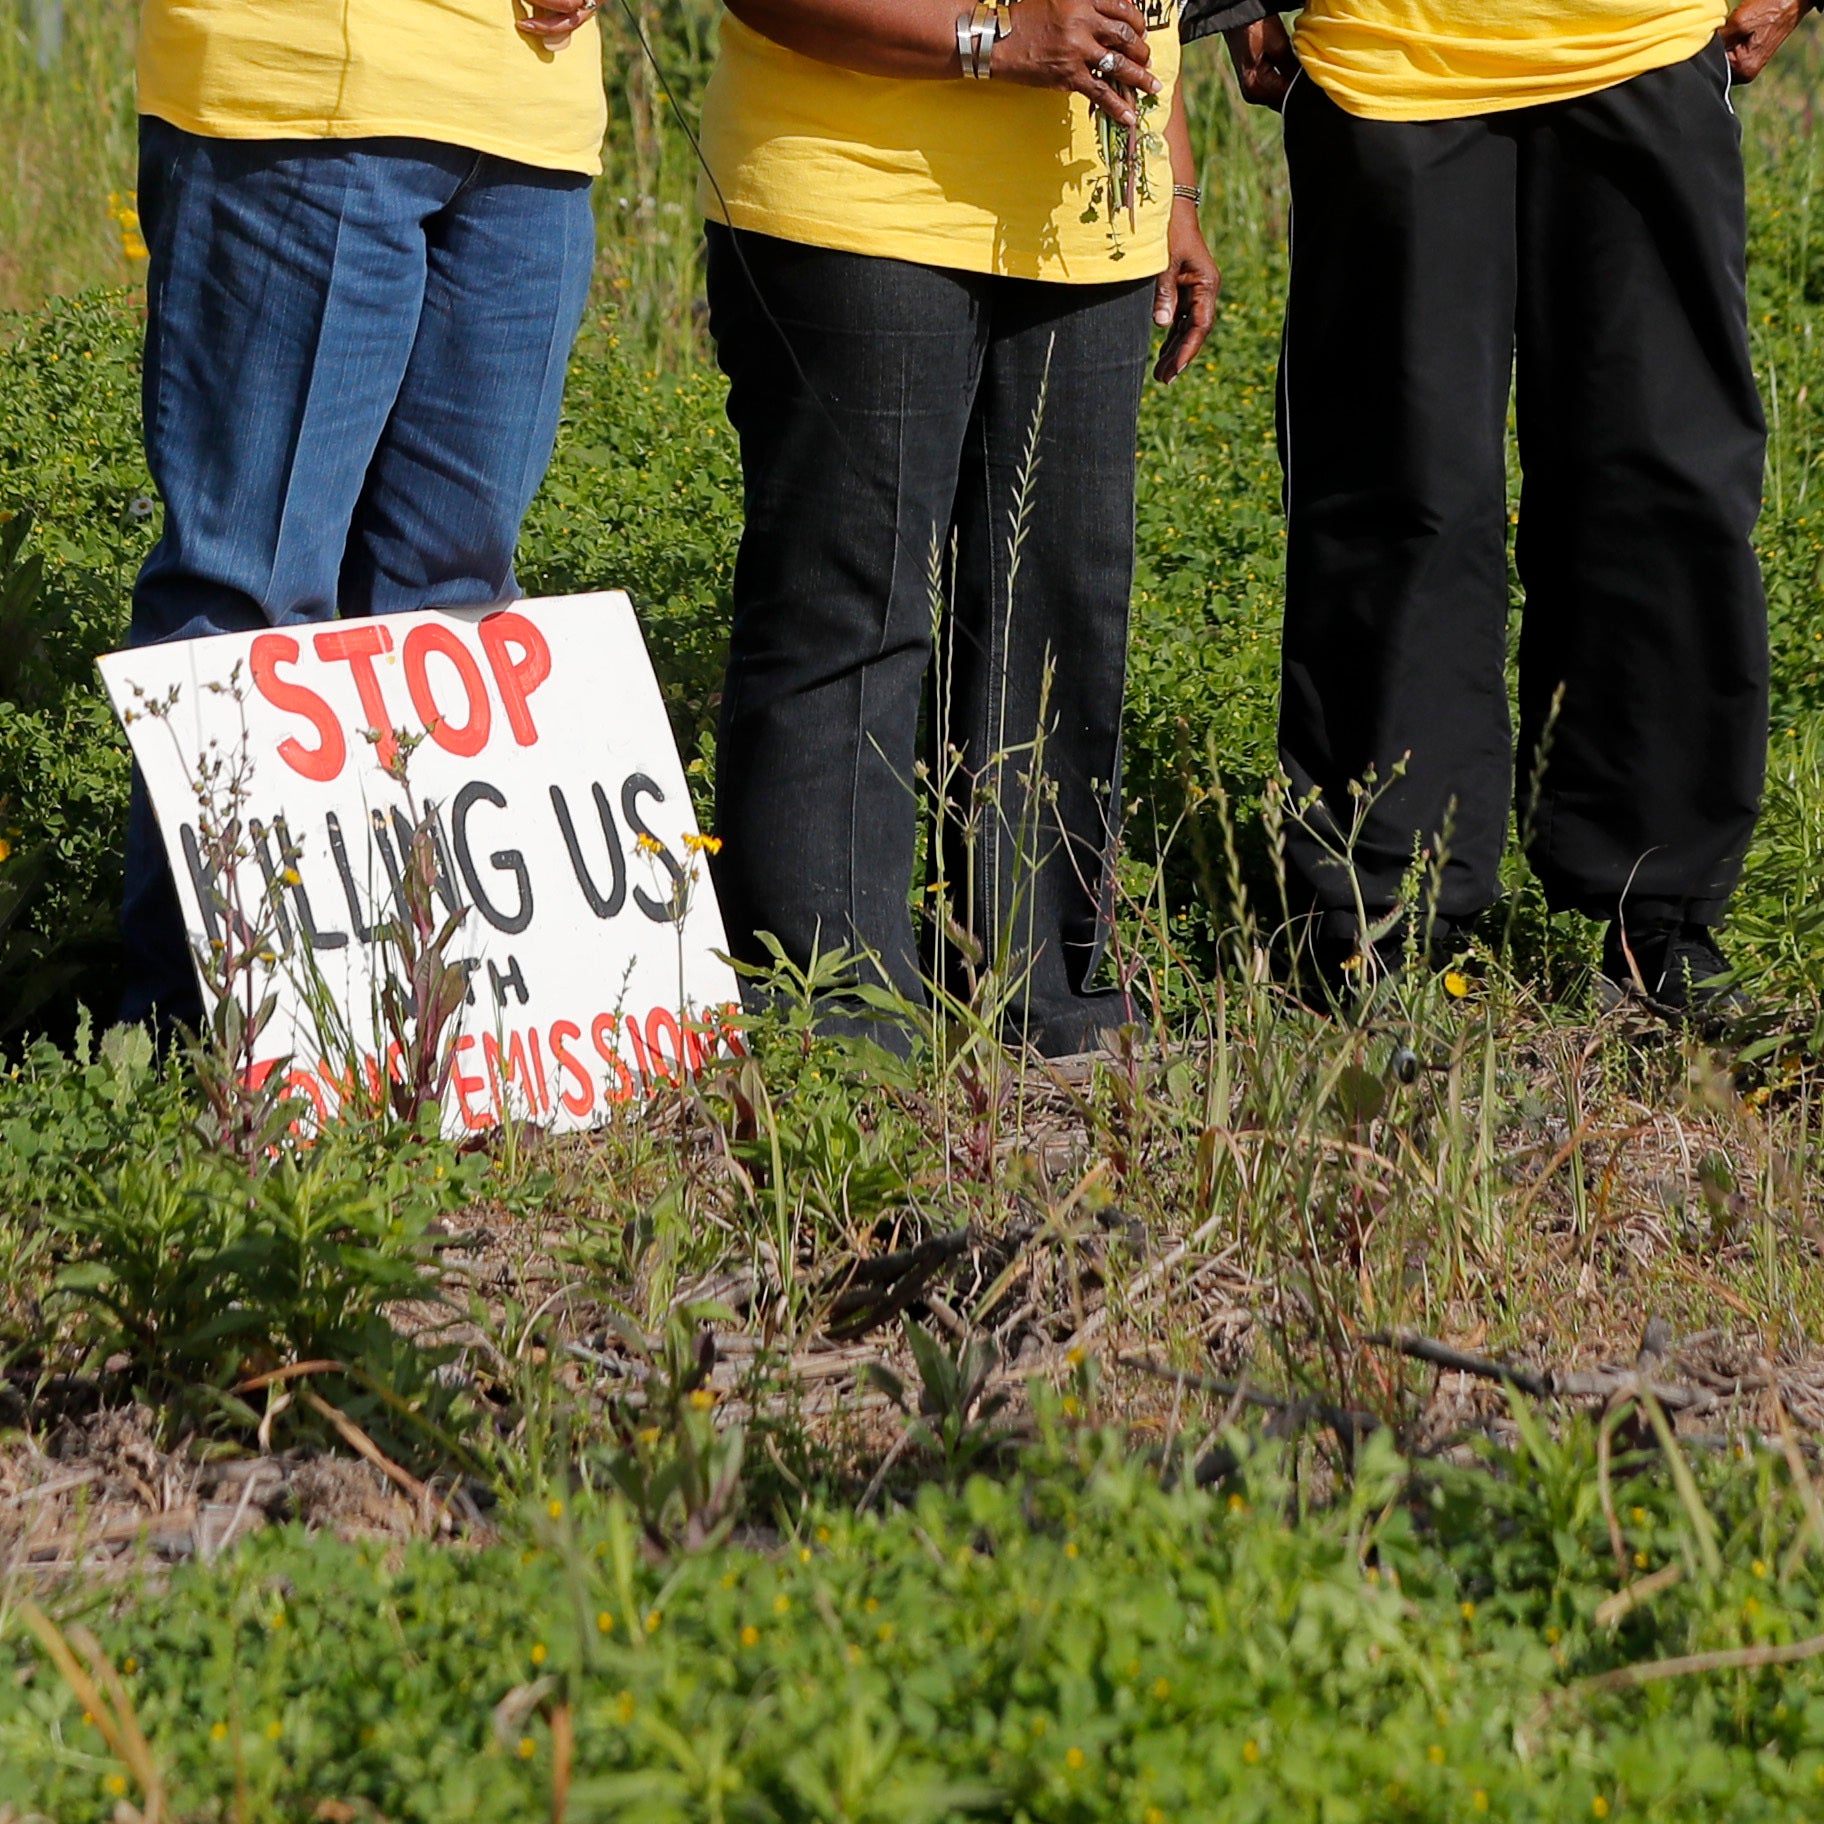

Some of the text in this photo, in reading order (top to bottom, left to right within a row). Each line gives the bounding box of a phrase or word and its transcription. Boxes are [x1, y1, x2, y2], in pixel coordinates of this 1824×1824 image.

[249, 611, 552, 782] STOP
[180, 772, 688, 975] KILLING US
